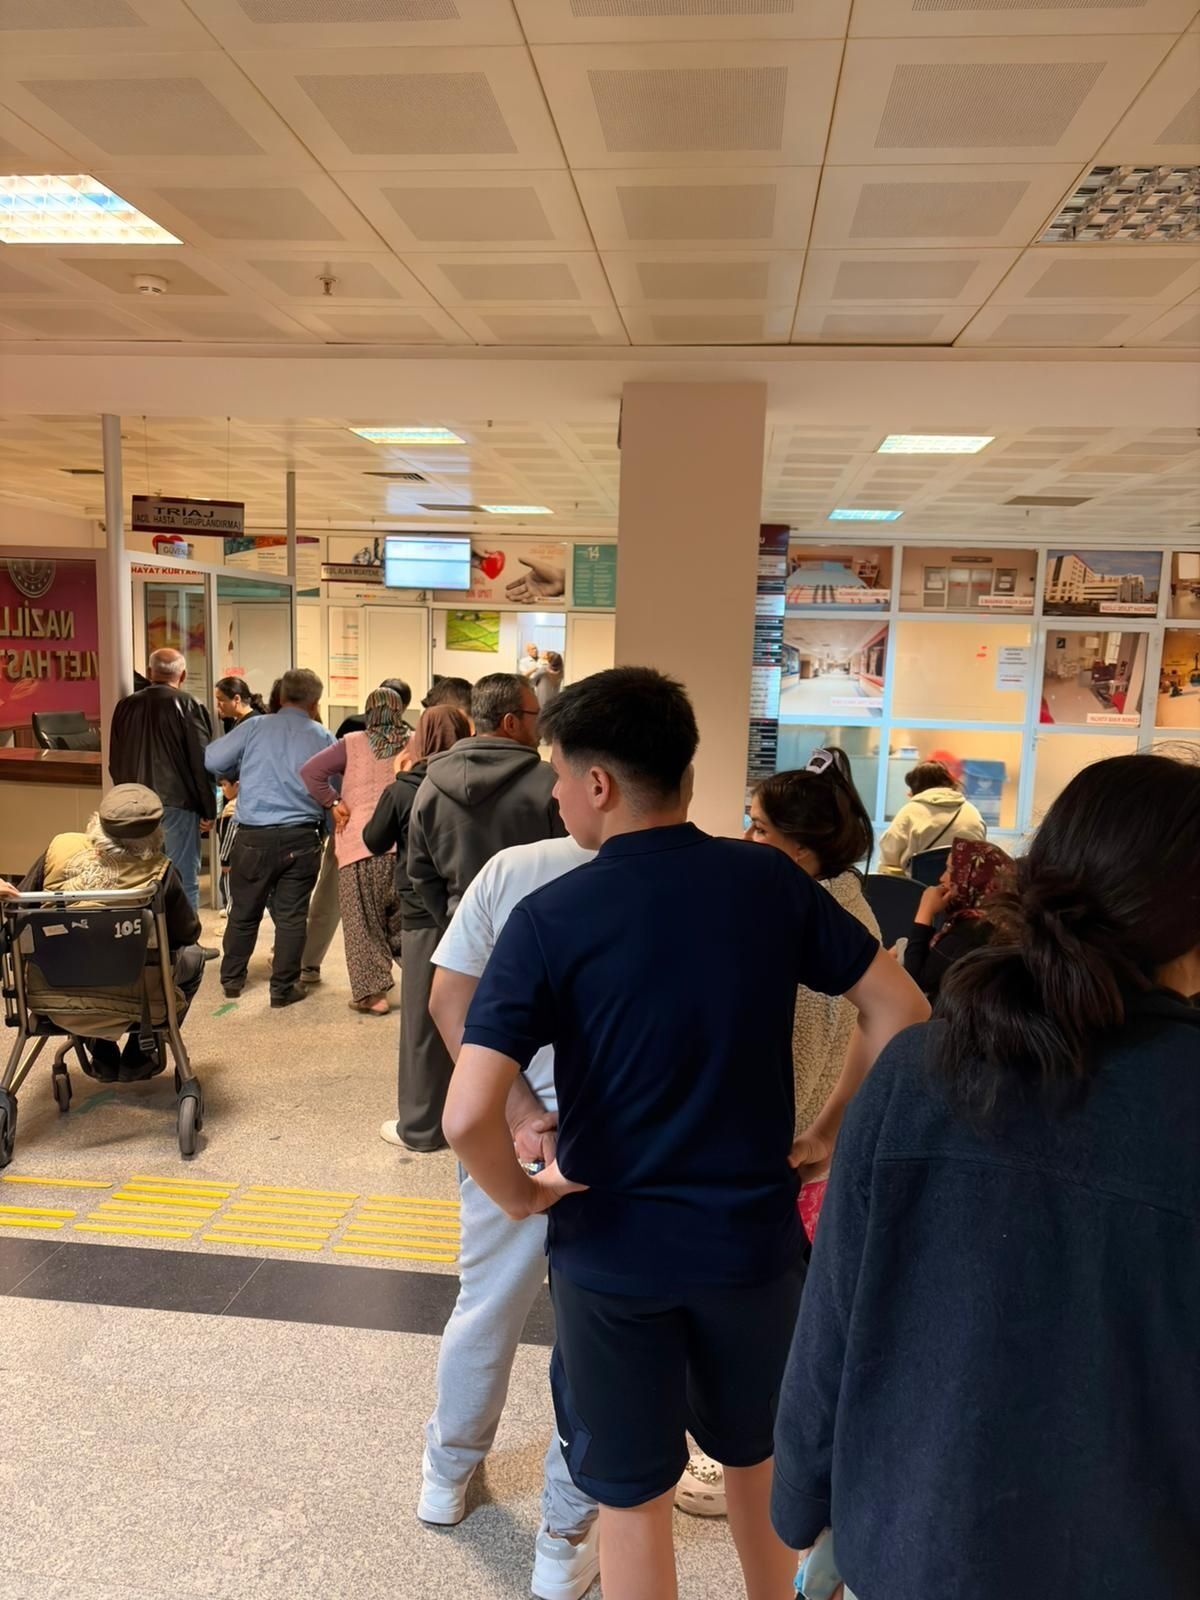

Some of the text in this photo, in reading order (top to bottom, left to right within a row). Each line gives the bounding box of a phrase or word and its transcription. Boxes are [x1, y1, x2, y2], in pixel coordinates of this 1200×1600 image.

[153, 507, 214, 518] TRİAJ
[153, 516, 175, 524] HASTA
[131, 566, 161, 574] HAYAT
[115, 919, 141, 938] 105
